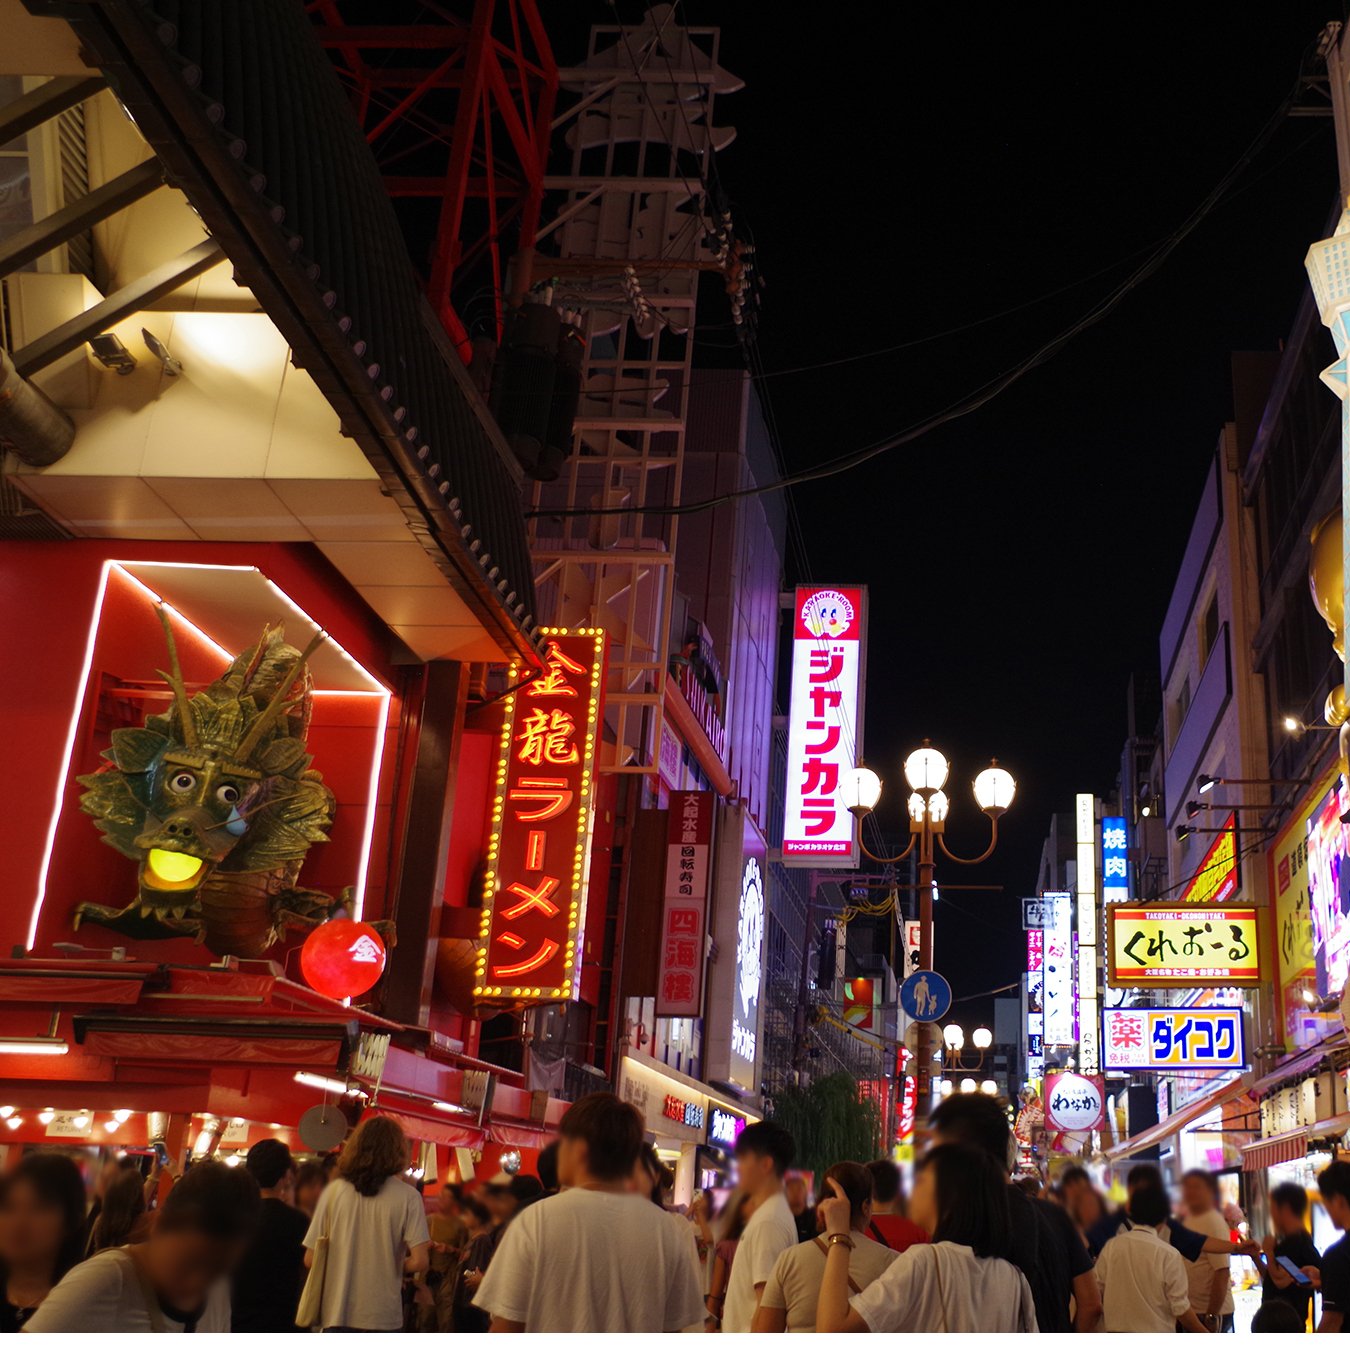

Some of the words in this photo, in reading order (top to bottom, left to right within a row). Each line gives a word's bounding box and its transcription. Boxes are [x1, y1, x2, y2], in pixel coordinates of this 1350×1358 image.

[801, 647, 844, 836] ジャンカラ
[493, 642, 588, 978] 金龍ラーメン
[1103, 827, 1128, 878] 焼肉
[1112, 1013, 1142, 1049] 薬
[1153, 1017, 1235, 1060] ダイコク
[1052, 1093, 1097, 1112] わなか
